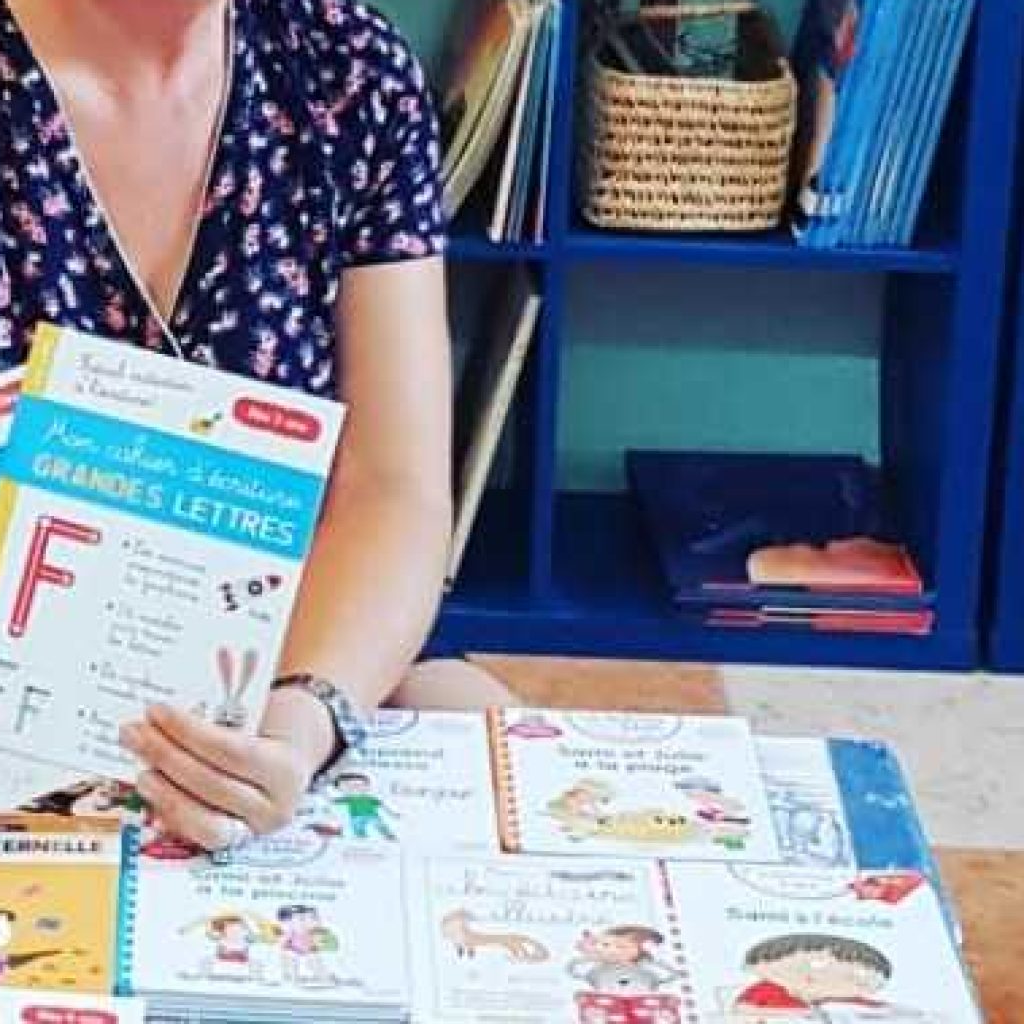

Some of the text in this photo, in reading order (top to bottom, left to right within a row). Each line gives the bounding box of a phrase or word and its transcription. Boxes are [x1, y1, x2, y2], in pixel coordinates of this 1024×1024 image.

[33, 452, 295, 545] GRANDES LETTRES
[8, 514, 102, 638] F
